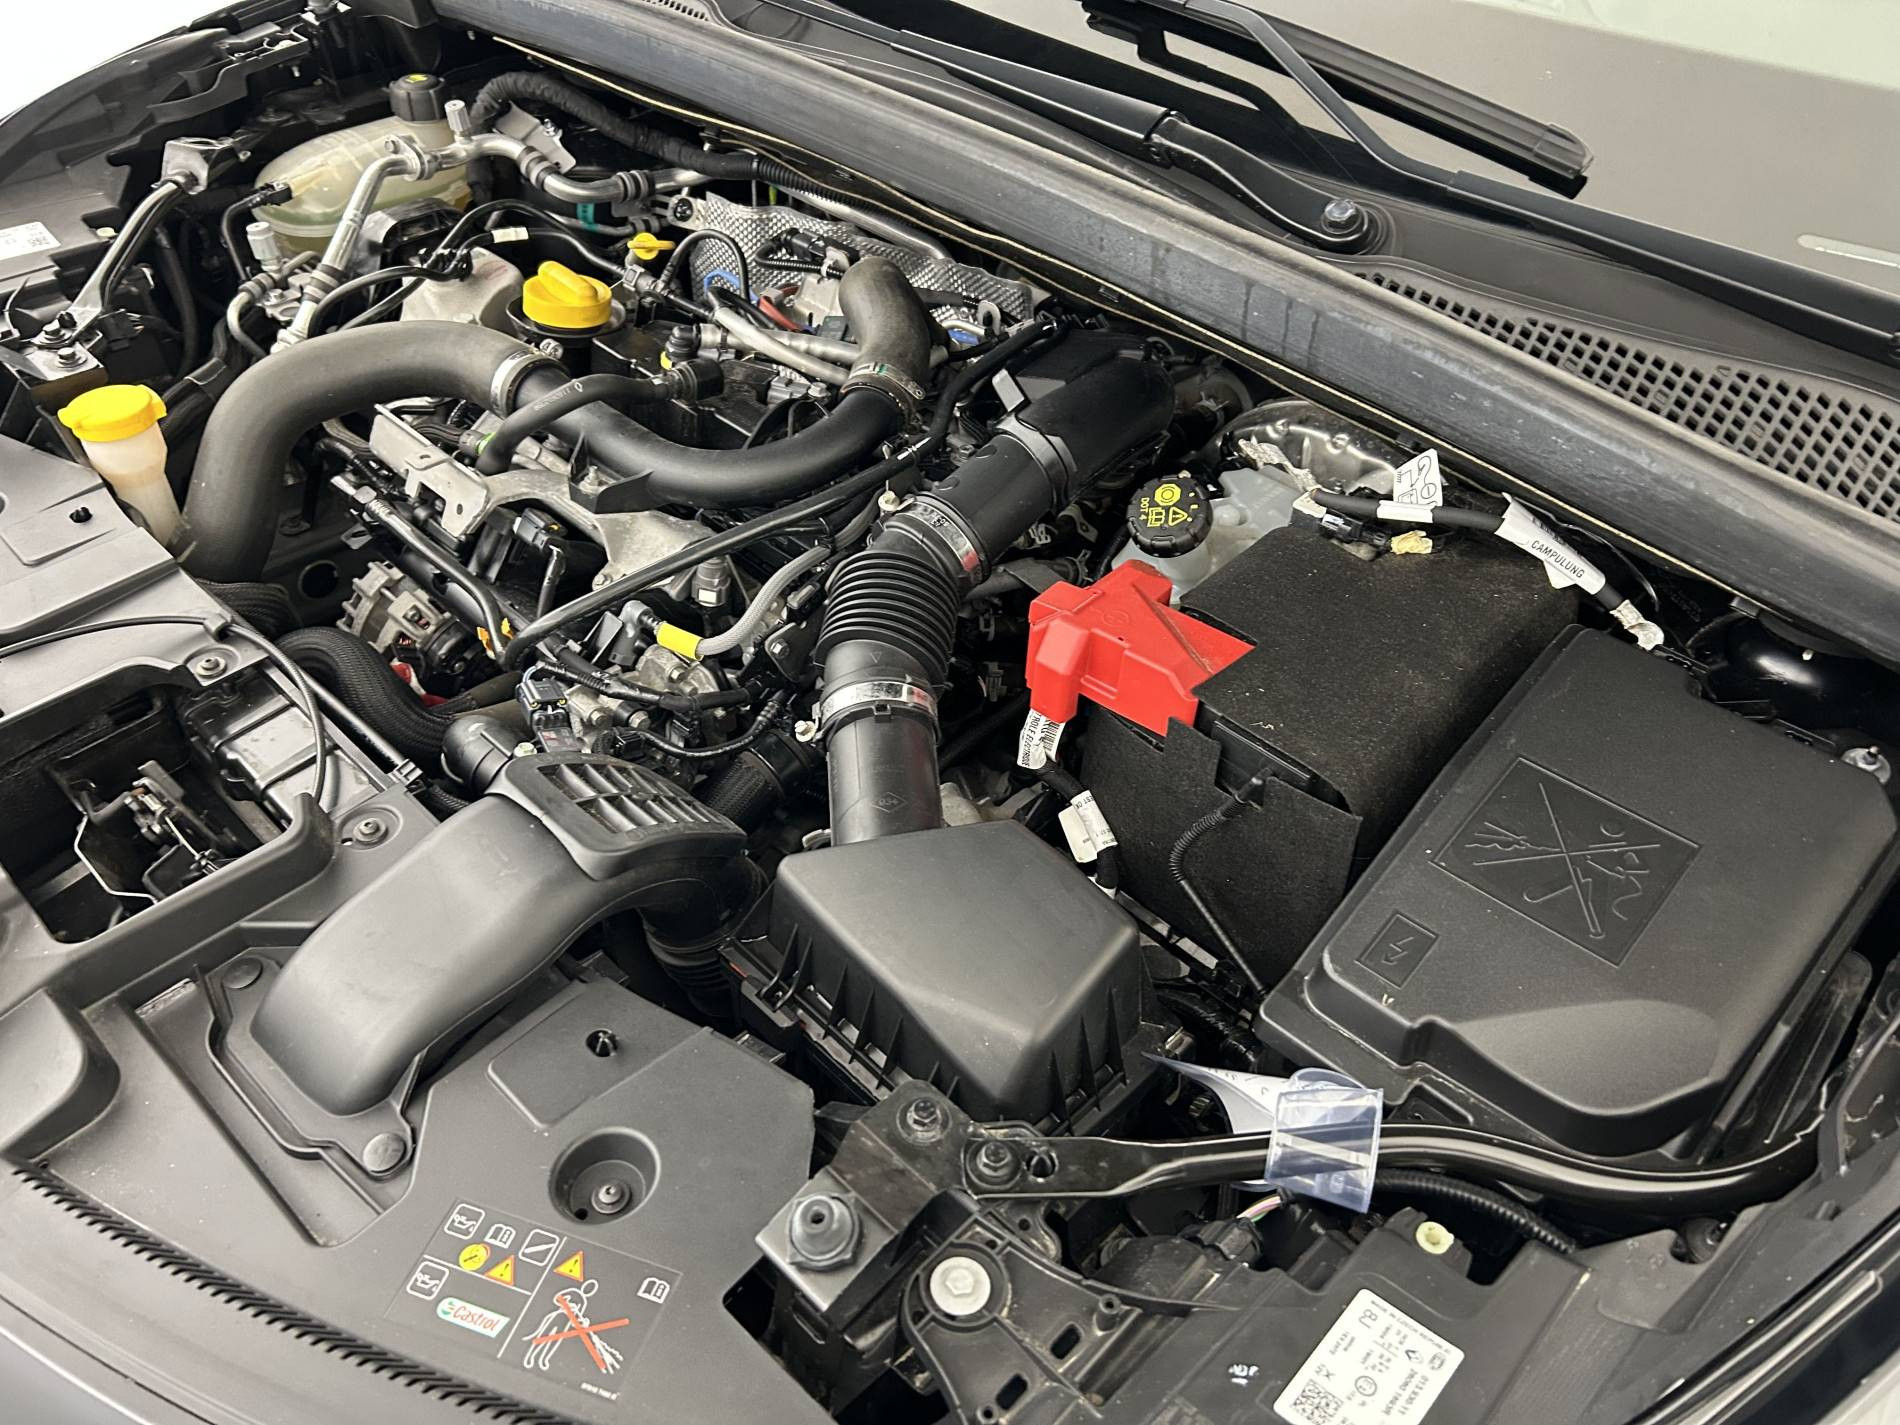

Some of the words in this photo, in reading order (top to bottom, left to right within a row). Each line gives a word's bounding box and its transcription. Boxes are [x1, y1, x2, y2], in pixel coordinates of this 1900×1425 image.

[1140, 497, 1150, 513] DOT
[1530, 540, 1585, 579] CAMPULUNG
[452, 1305, 503, 1332] Castrol
